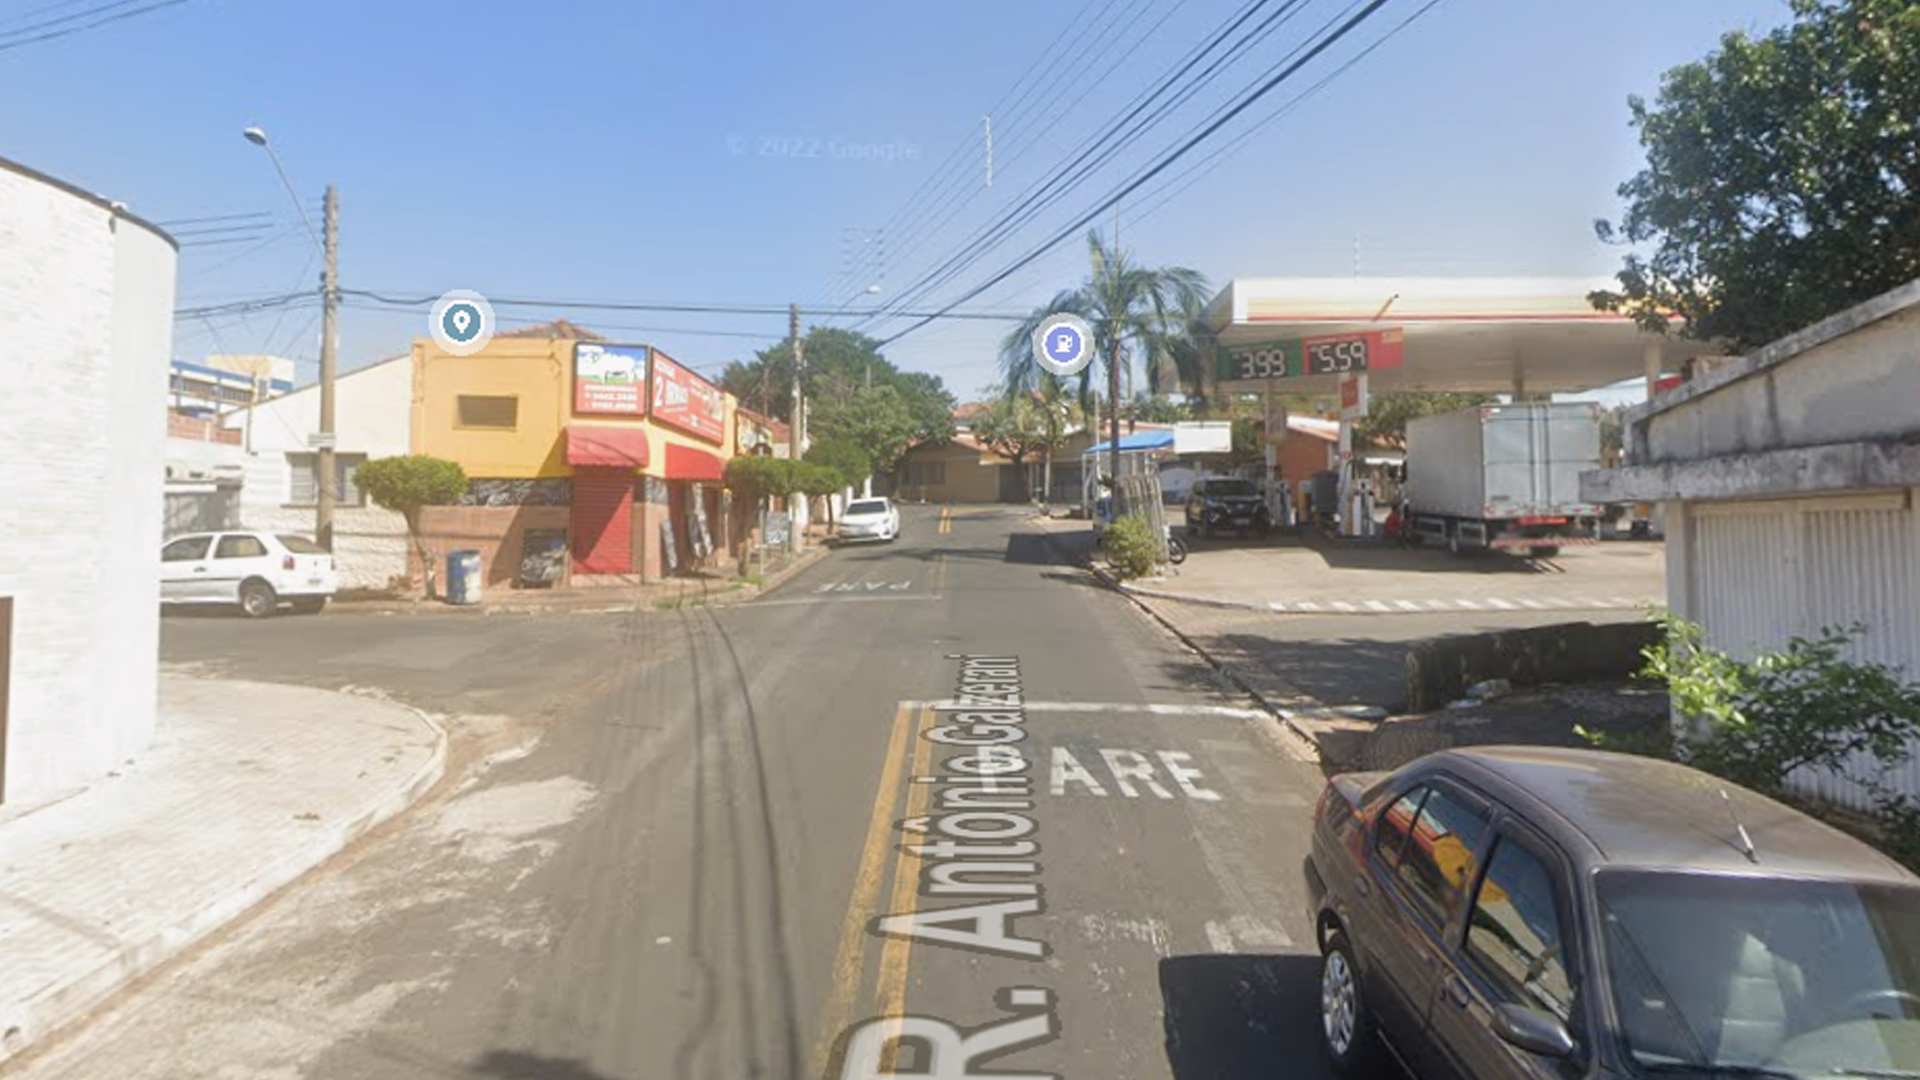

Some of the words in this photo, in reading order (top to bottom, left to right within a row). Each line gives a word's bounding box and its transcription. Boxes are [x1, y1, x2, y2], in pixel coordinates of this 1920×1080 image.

[1241, 349, 1285, 378] 3.99
[1317, 341, 1366, 372] 5.59
[811, 580, 912, 594] PARE
